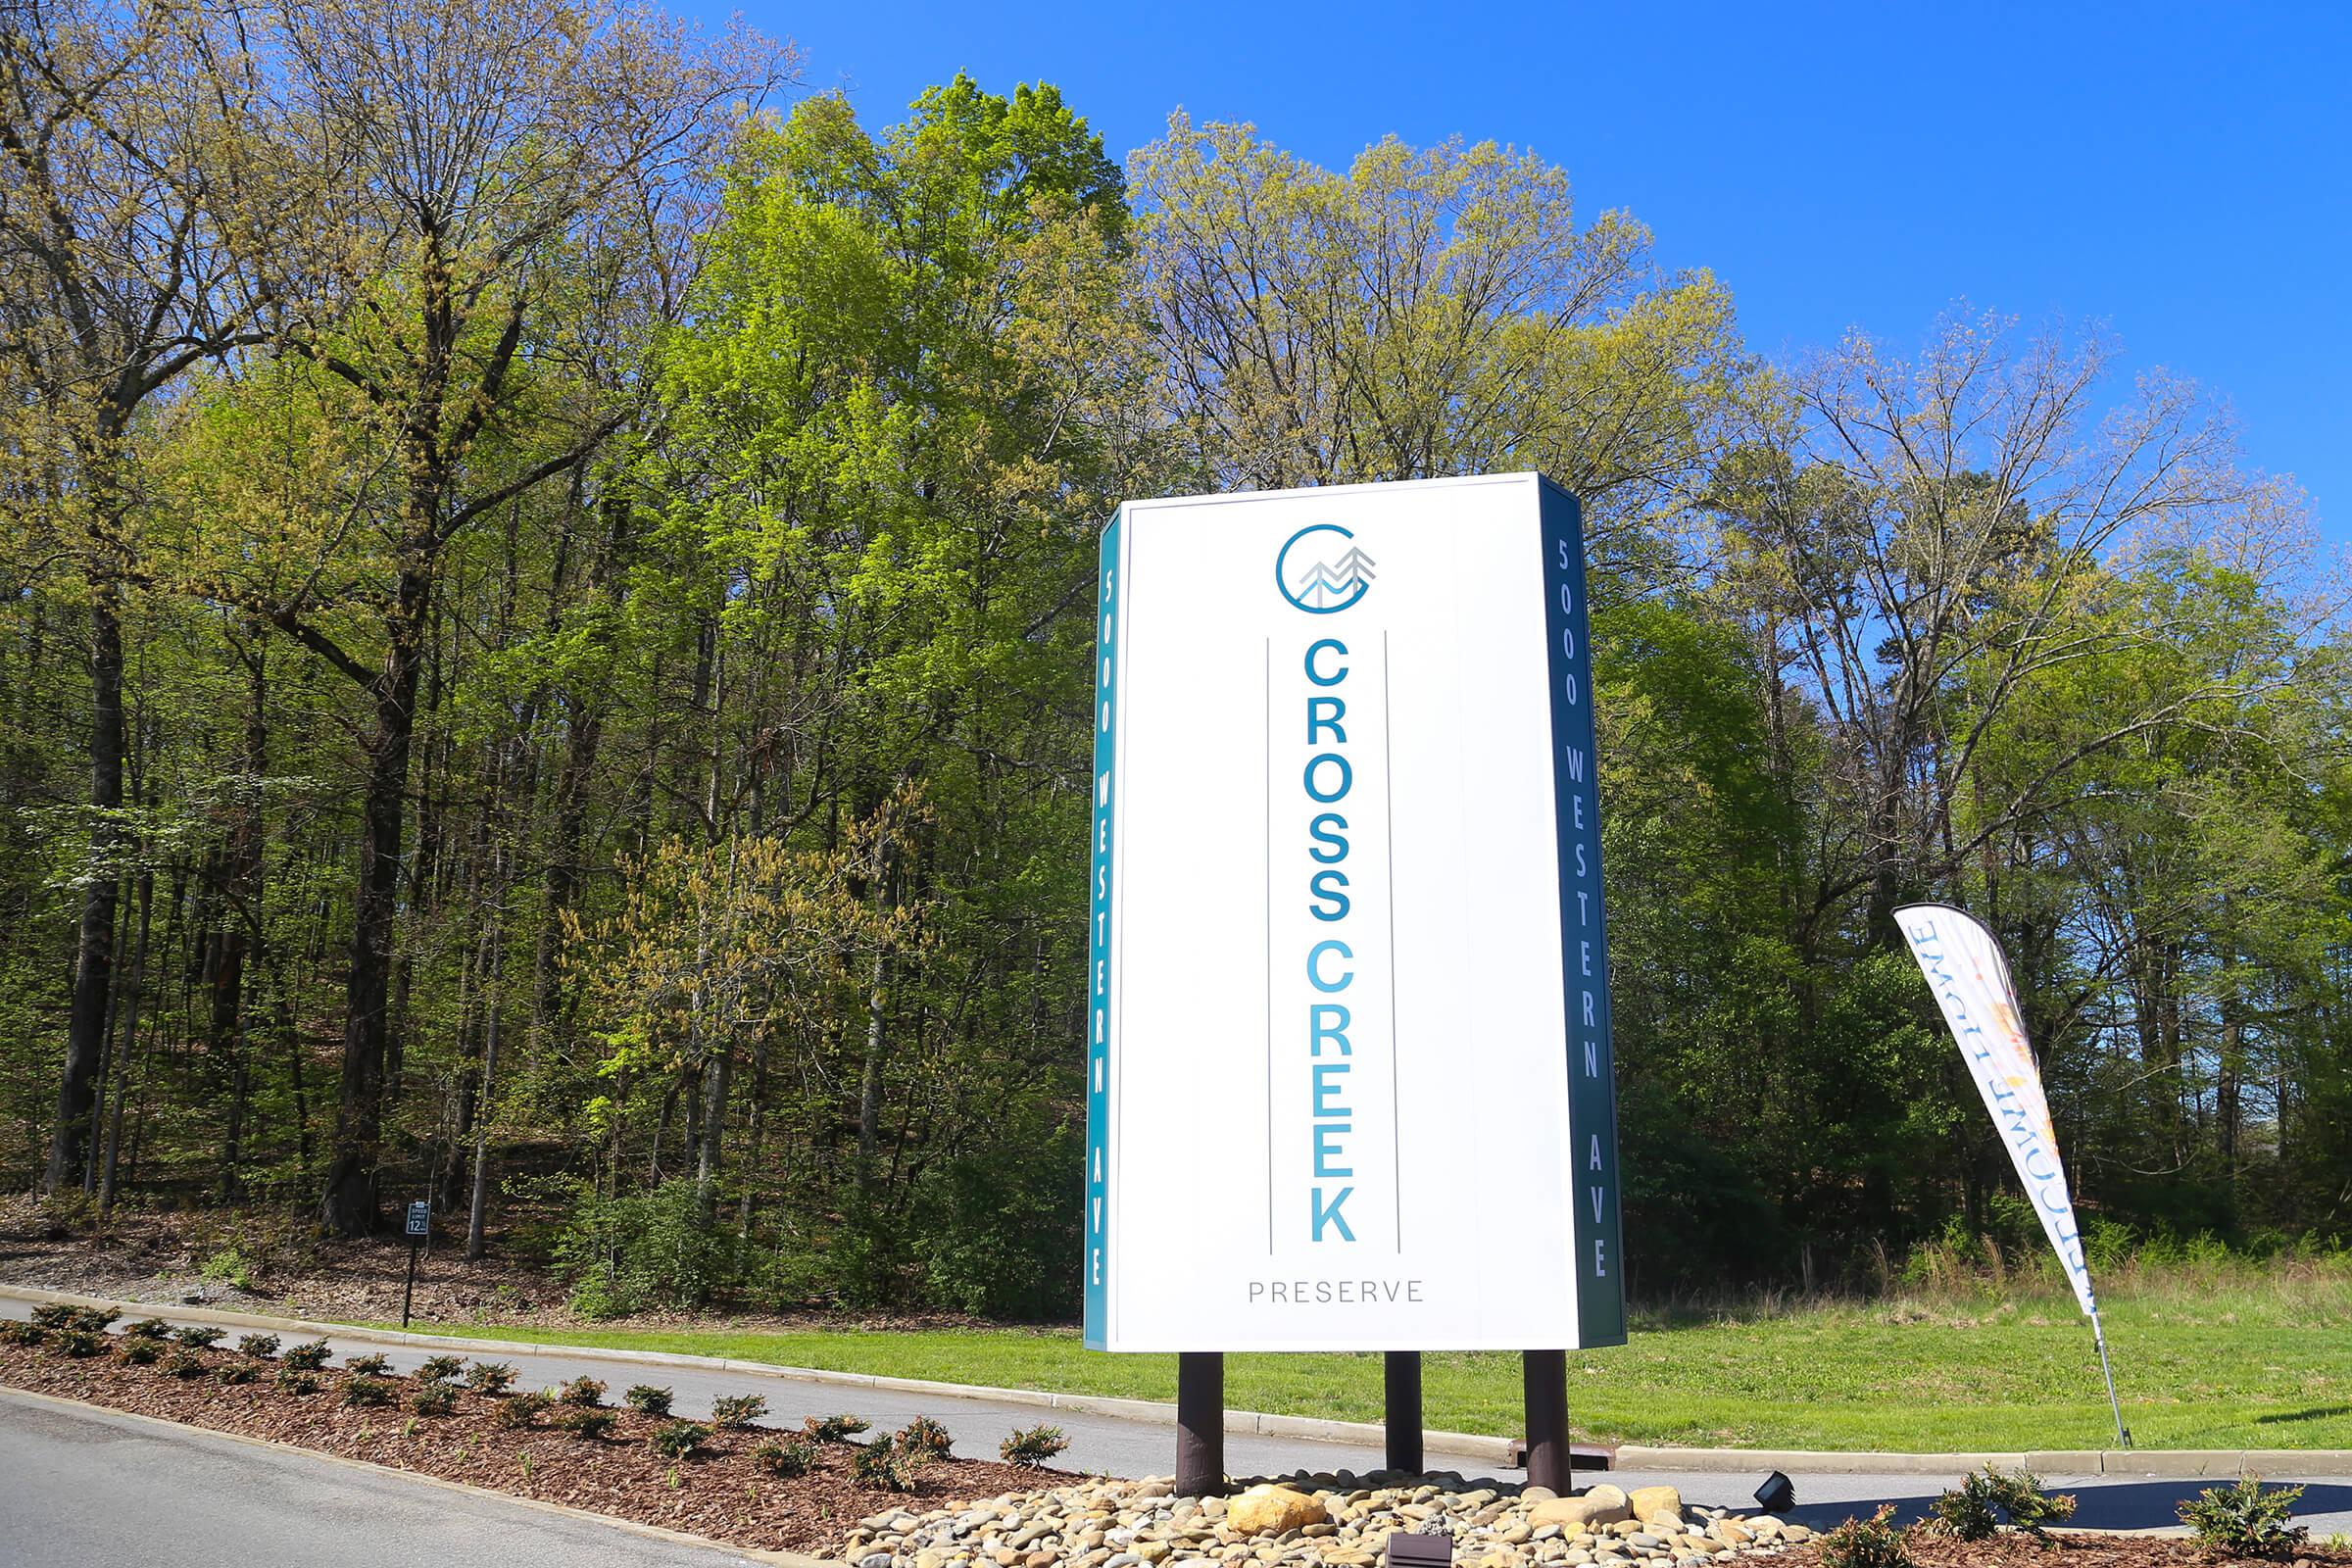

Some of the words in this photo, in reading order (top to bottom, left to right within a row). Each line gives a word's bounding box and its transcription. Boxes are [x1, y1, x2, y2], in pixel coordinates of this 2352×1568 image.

[1102, 568, 1113, 733] 5000
[1558, 539, 1577, 706] 5000
[1303, 638, 1352, 922] CROSS
[1094, 769, 1110, 1095] WESTERN
[1566, 745, 1598, 1078] WESTERN
[1306, 940, 1357, 1242] CREEK
[1092, 1147, 1102, 1286] AVE
[1589, 1134, 1606, 1277] AVE
[1249, 1280, 1424, 1303] PRESERVE
